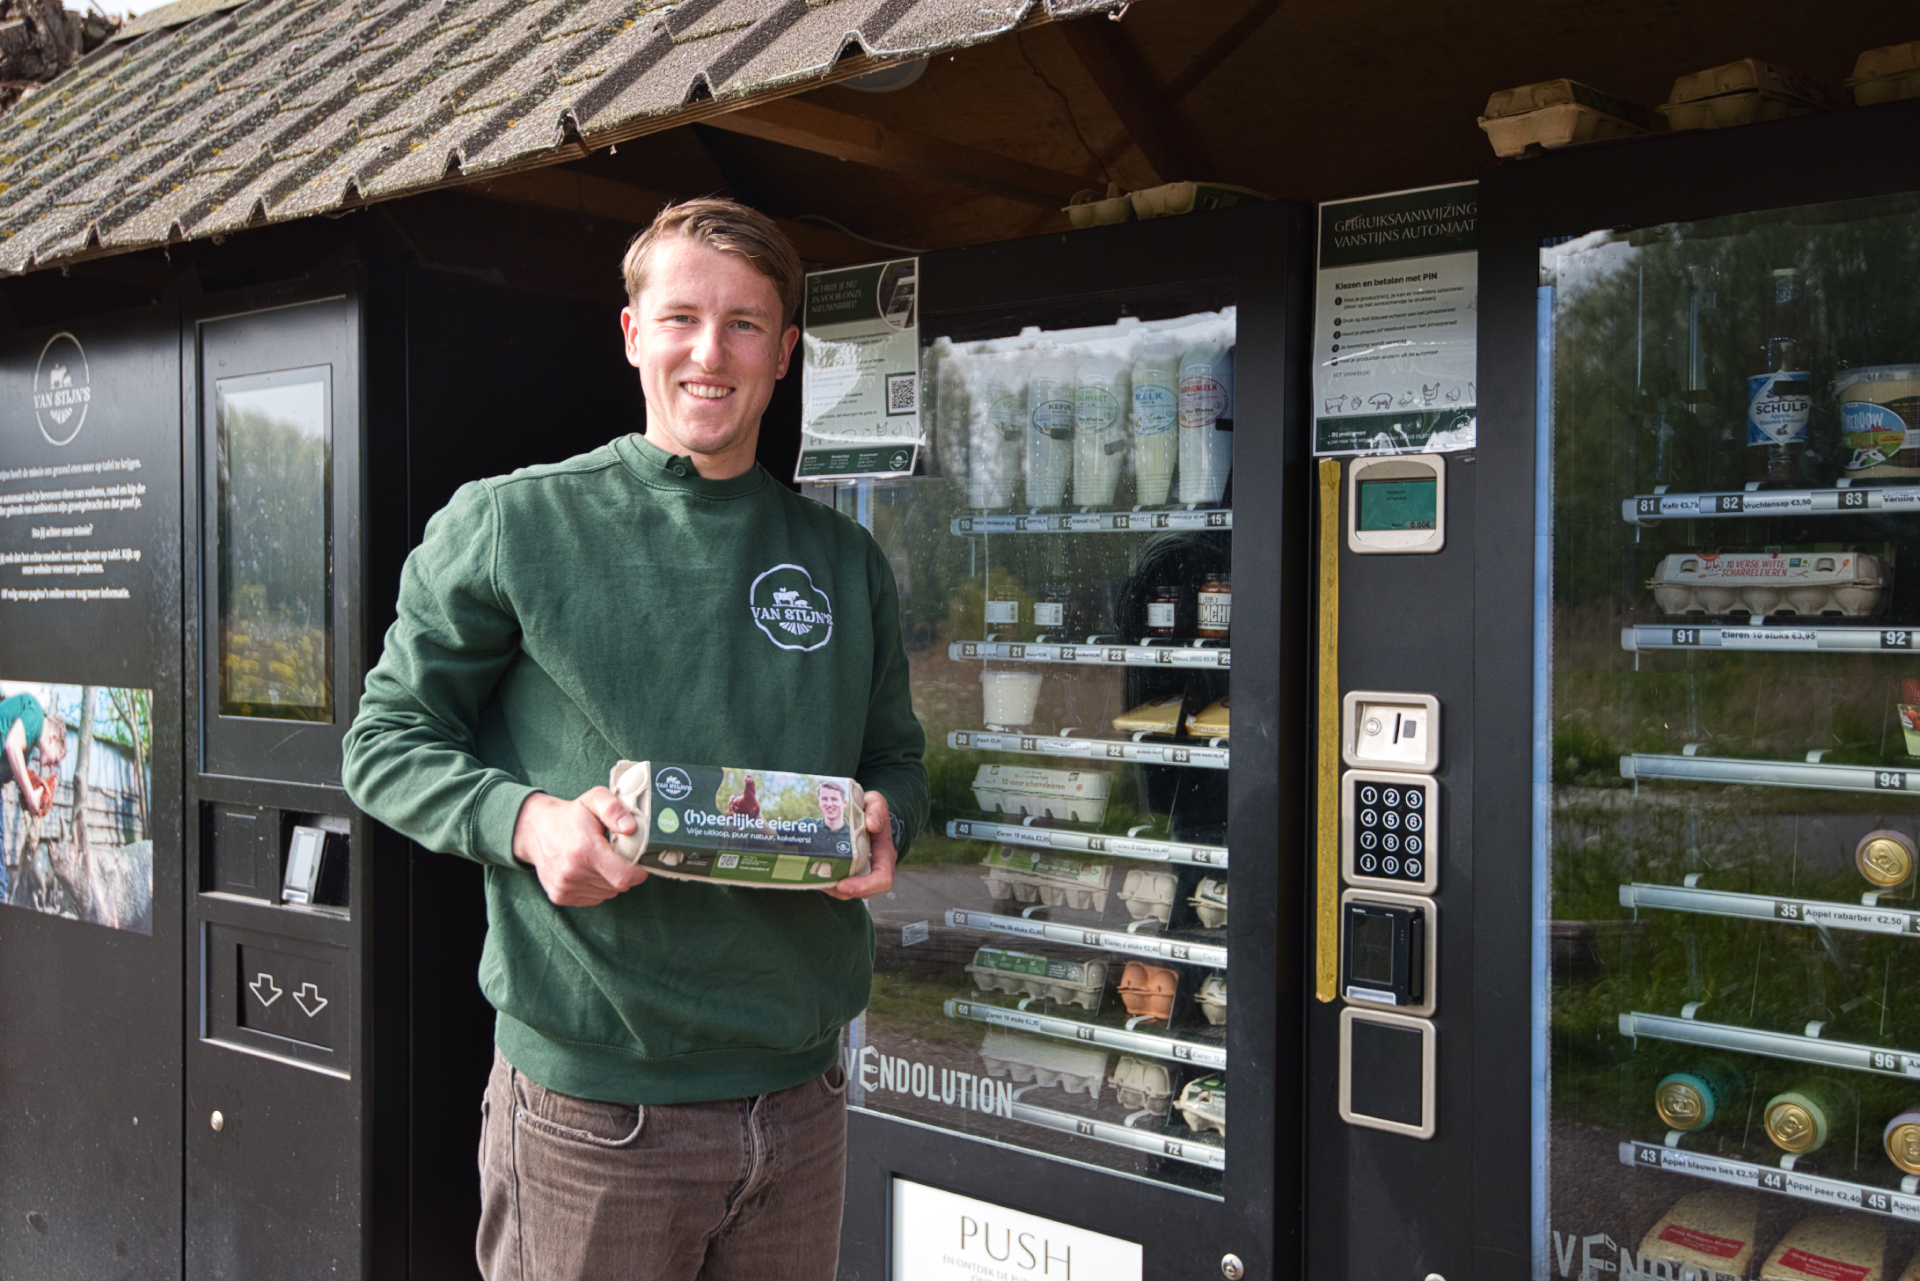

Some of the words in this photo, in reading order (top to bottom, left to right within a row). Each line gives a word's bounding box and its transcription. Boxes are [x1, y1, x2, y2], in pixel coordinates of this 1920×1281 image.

[1334, 202, 1478, 233] GEBRUIKSAANWIJZING
[1334, 229, 1400, 248] VANSTIJNS
[1401, 219, 1478, 240] AUTOMAAT
[812, 282, 837, 294] SCHRIJF
[1335, 282, 1361, 291] Kiezen
[1374, 277, 1404, 287] betalen
[1406, 274, 1421, 283] met
[1423, 272, 1438, 281] PIN
[821, 292, 842, 303] VOOR
[842, 289, 862, 299] ONZE
[1360, 293, 1390, 302] product(en),
[1437, 286, 1464, 294] selecteren
[1414, 295, 1437, 303] drukken)
[811, 300, 857, 314] NIEUWSBRIEF!
[1425, 307, 1456, 316] pinapparaat
[1427, 320, 1458, 328] pinapparaat
[1346, 342, 1370, 350] bestelling
[1355, 355, 1381, 363] producten
[1415, 349, 1439, 357] automaat
[34, 392, 53, 409] VAN
[54, 387, 90, 407] STIJN'S
[1048, 403, 1072, 411] KEFIR
[1756, 402, 1808, 415] SCHULP
[1338, 430, 1366, 438] problemen
[1640, 499, 1655, 512] 81
[1662, 502, 1679, 510] Kefir
[1722, 496, 1739, 510] 82
[1743, 501, 1789, 510] Vruchtensap
[1790, 499, 1812, 507] €3,50
[1845, 492, 1862, 506] 83
[961, 520, 970, 529] 10
[1019, 518, 1028, 528] 11
[1062, 517, 1072, 528] 12
[1116, 516, 1127, 527] 13
[1210, 514, 1222, 525] 15
[1410, 521, 1431, 529] 0.00€
[1735, 560, 1760, 568] VERSE
[1761, 559, 1785, 568] WITTE
[1721, 568, 1788, 577] SCHARRELEIEREN
[750, 606, 781, 620] VAN
[784, 608, 833, 626] STIJN'S
[1198, 604, 1231, 623] IMCHI
[1677, 629, 1694, 643] 91
[1721, 631, 1750, 639] Eieren
[1752, 631, 1763, 639] 10
[1764, 631, 1789, 640] stuks
[1791, 632, 1816, 641] €3,95
[1886, 631, 1906, 646] 92
[965, 645, 975, 655] 20
[1011, 646, 1022, 657] 21
[1062, 648, 1073, 658] 22
[1110, 650, 1122, 661] 23
[1162, 651, 1172, 662] 24
[957, 734, 967, 744] 30
[1023, 739, 1033, 749] 31
[1109, 746, 1120, 756] 32
[1175, 750, 1187, 762] 33
[1024, 779, 1066, 790] scharreleieren
[1879, 772, 1901, 788] 94
[1366, 790, 1371, 802] 1
[1387, 791, 1395, 803] 2
[1410, 793, 1418, 805] 3
[659, 818, 678, 826] 10st.
[684, 808, 765, 831] (h)eerlijke
[767, 816, 818, 834] eieren
[1364, 812, 1373, 824] 4
[1387, 814, 1395, 826] 5
[1409, 816, 1418, 828] 6
[686, 827, 703, 836] Vrije
[703, 828, 731, 838] uitloop,
[731, 831, 750, 839] puur
[749, 833, 776, 842] natuur,
[776, 834, 812, 844] kakelvers!
[959, 824, 969, 834] 40
[996, 830, 1013, 838] Eieren
[1020, 833, 1035, 841] stuks
[1090, 838, 1101, 850] 41
[1136, 844, 1151, 852] stuks
[1152, 845, 1169, 854] €2,40
[1365, 835, 1372, 846] 7
[1387, 837, 1395, 848] 8
[1409, 839, 1417, 850] 9
[1195, 850, 1207, 862] 42
[1387, 859, 1394, 871] 0
[1780, 903, 1798, 918] 35
[1805, 909, 1831, 918] Appel
[1833, 912, 1873, 922] rabarber
[1877, 915, 1902, 925] €2,50
[955, 913, 965, 924] 50
[990, 921, 1007, 930] Eieren
[1085, 933, 1096, 944] 51
[1104, 938, 1122, 948] Eieren
[1127, 942, 1143, 951] stuks
[1143, 944, 1158, 952] €2,40
[1173, 947, 1187, 958] 52
[958, 1004, 968, 1015] 60
[1010, 1015, 1024, 1023] stuks
[1079, 1028, 1090, 1039] 61
[1175, 1046, 1188, 1058] 62
[1192, 1052, 1212, 1060] Eieren
[1874, 1052, 1895, 1069] 96
[843, 1045, 1013, 1119] VENDOLUTION
[1080, 1122, 1091, 1134] 71
[1168, 1142, 1180, 1156] 72
[1640, 1149, 1656, 1163] 43
[1662, 1157, 1686, 1168] Appel
[1688, 1161, 1717, 1172] blauwe
[1719, 1166, 1734, 1175] bes
[1736, 1169, 1758, 1180] €2,50
[1764, 1173, 1781, 1189] 44
[1787, 1179, 1813, 1192] Appel
[1814, 1186, 1835, 1197] peer
[1837, 1191, 1861, 1203] €2,40
[1868, 1193, 1886, 1210] 45
[1893, 1200, 1920, 1213] Appel
[961, 1215, 1071, 1281] PUSH
[942, 1254, 954, 1264] EN
[956, 1258, 995, 1278] ONTDEK
[996, 1270, 1009, 1281] DE
